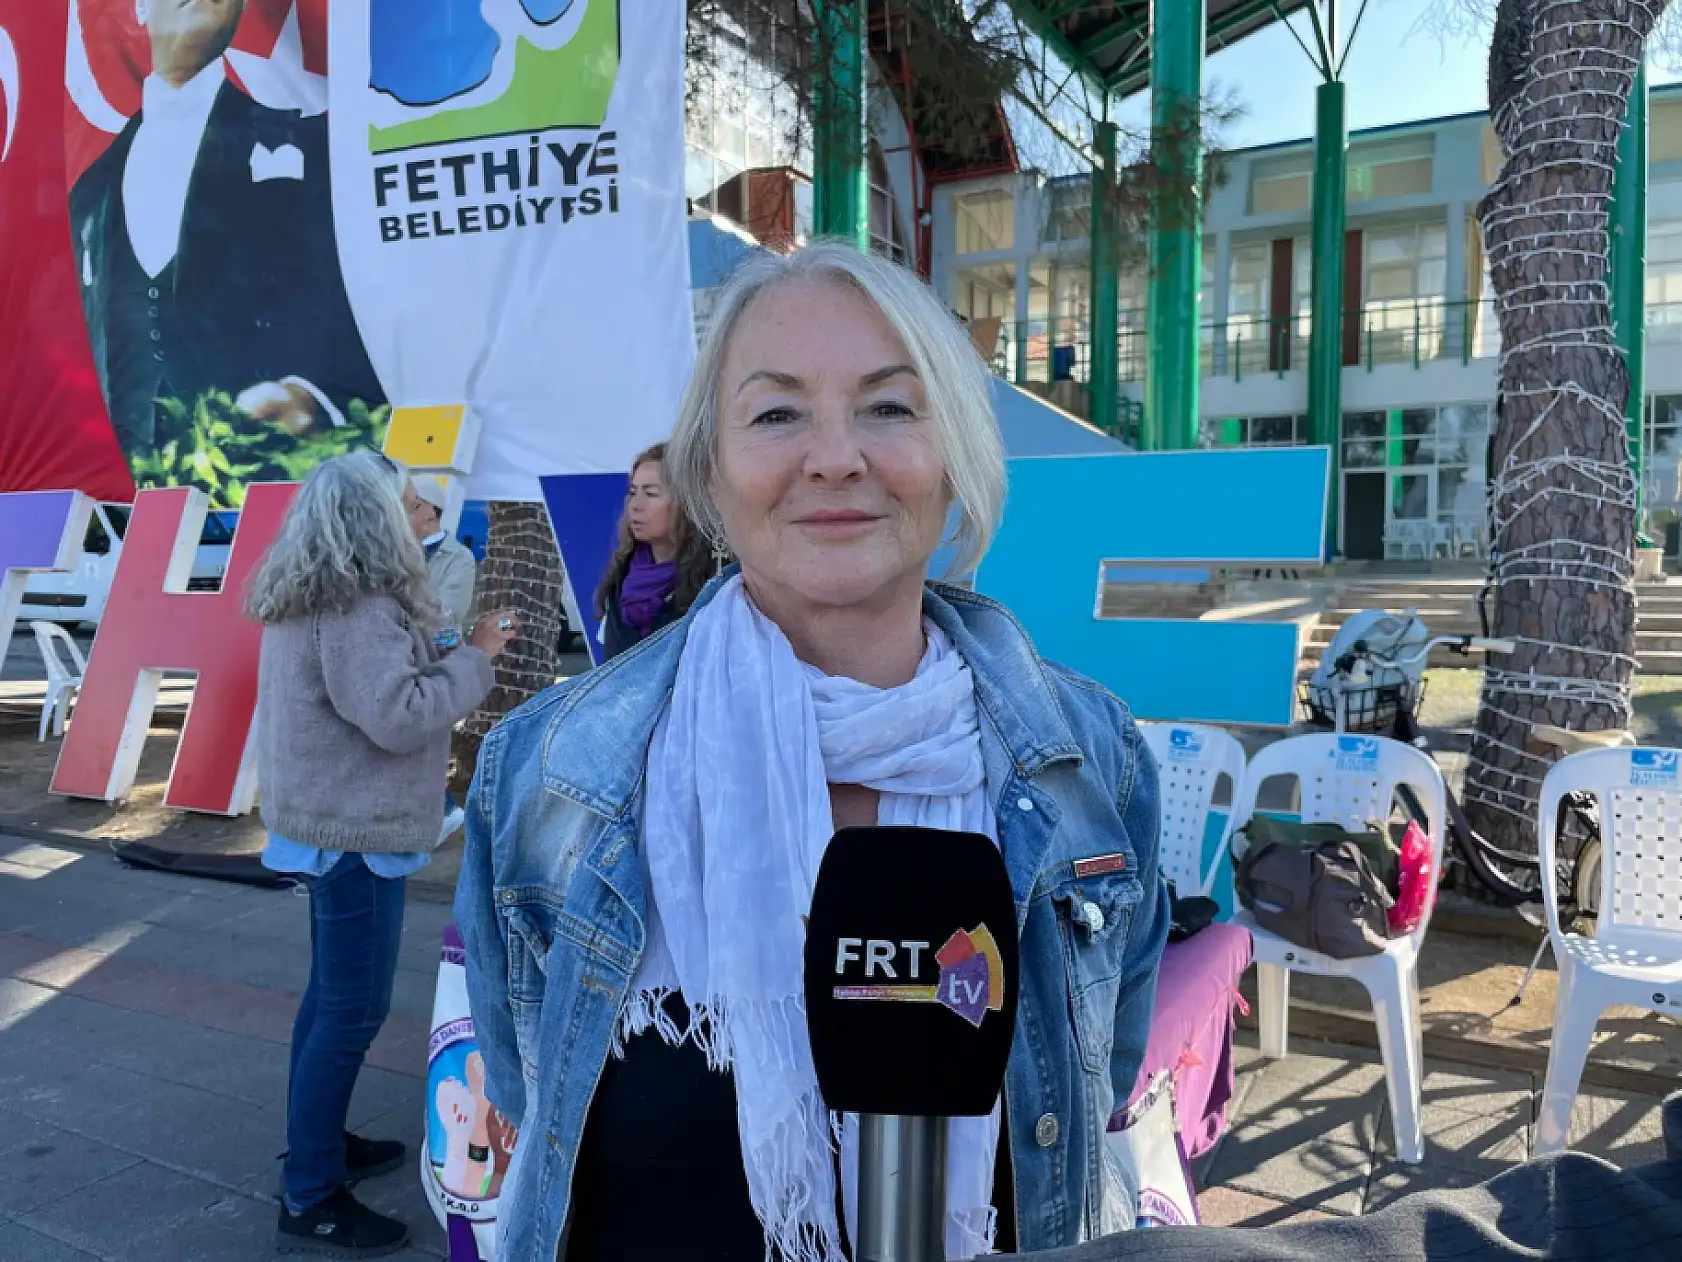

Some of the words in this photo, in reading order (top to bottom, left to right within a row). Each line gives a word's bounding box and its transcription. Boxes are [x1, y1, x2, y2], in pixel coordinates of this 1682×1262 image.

[374, 131, 619, 207] FETHİYE
[835, 937, 930, 979] FRT
[949, 973, 985, 1005] tv
